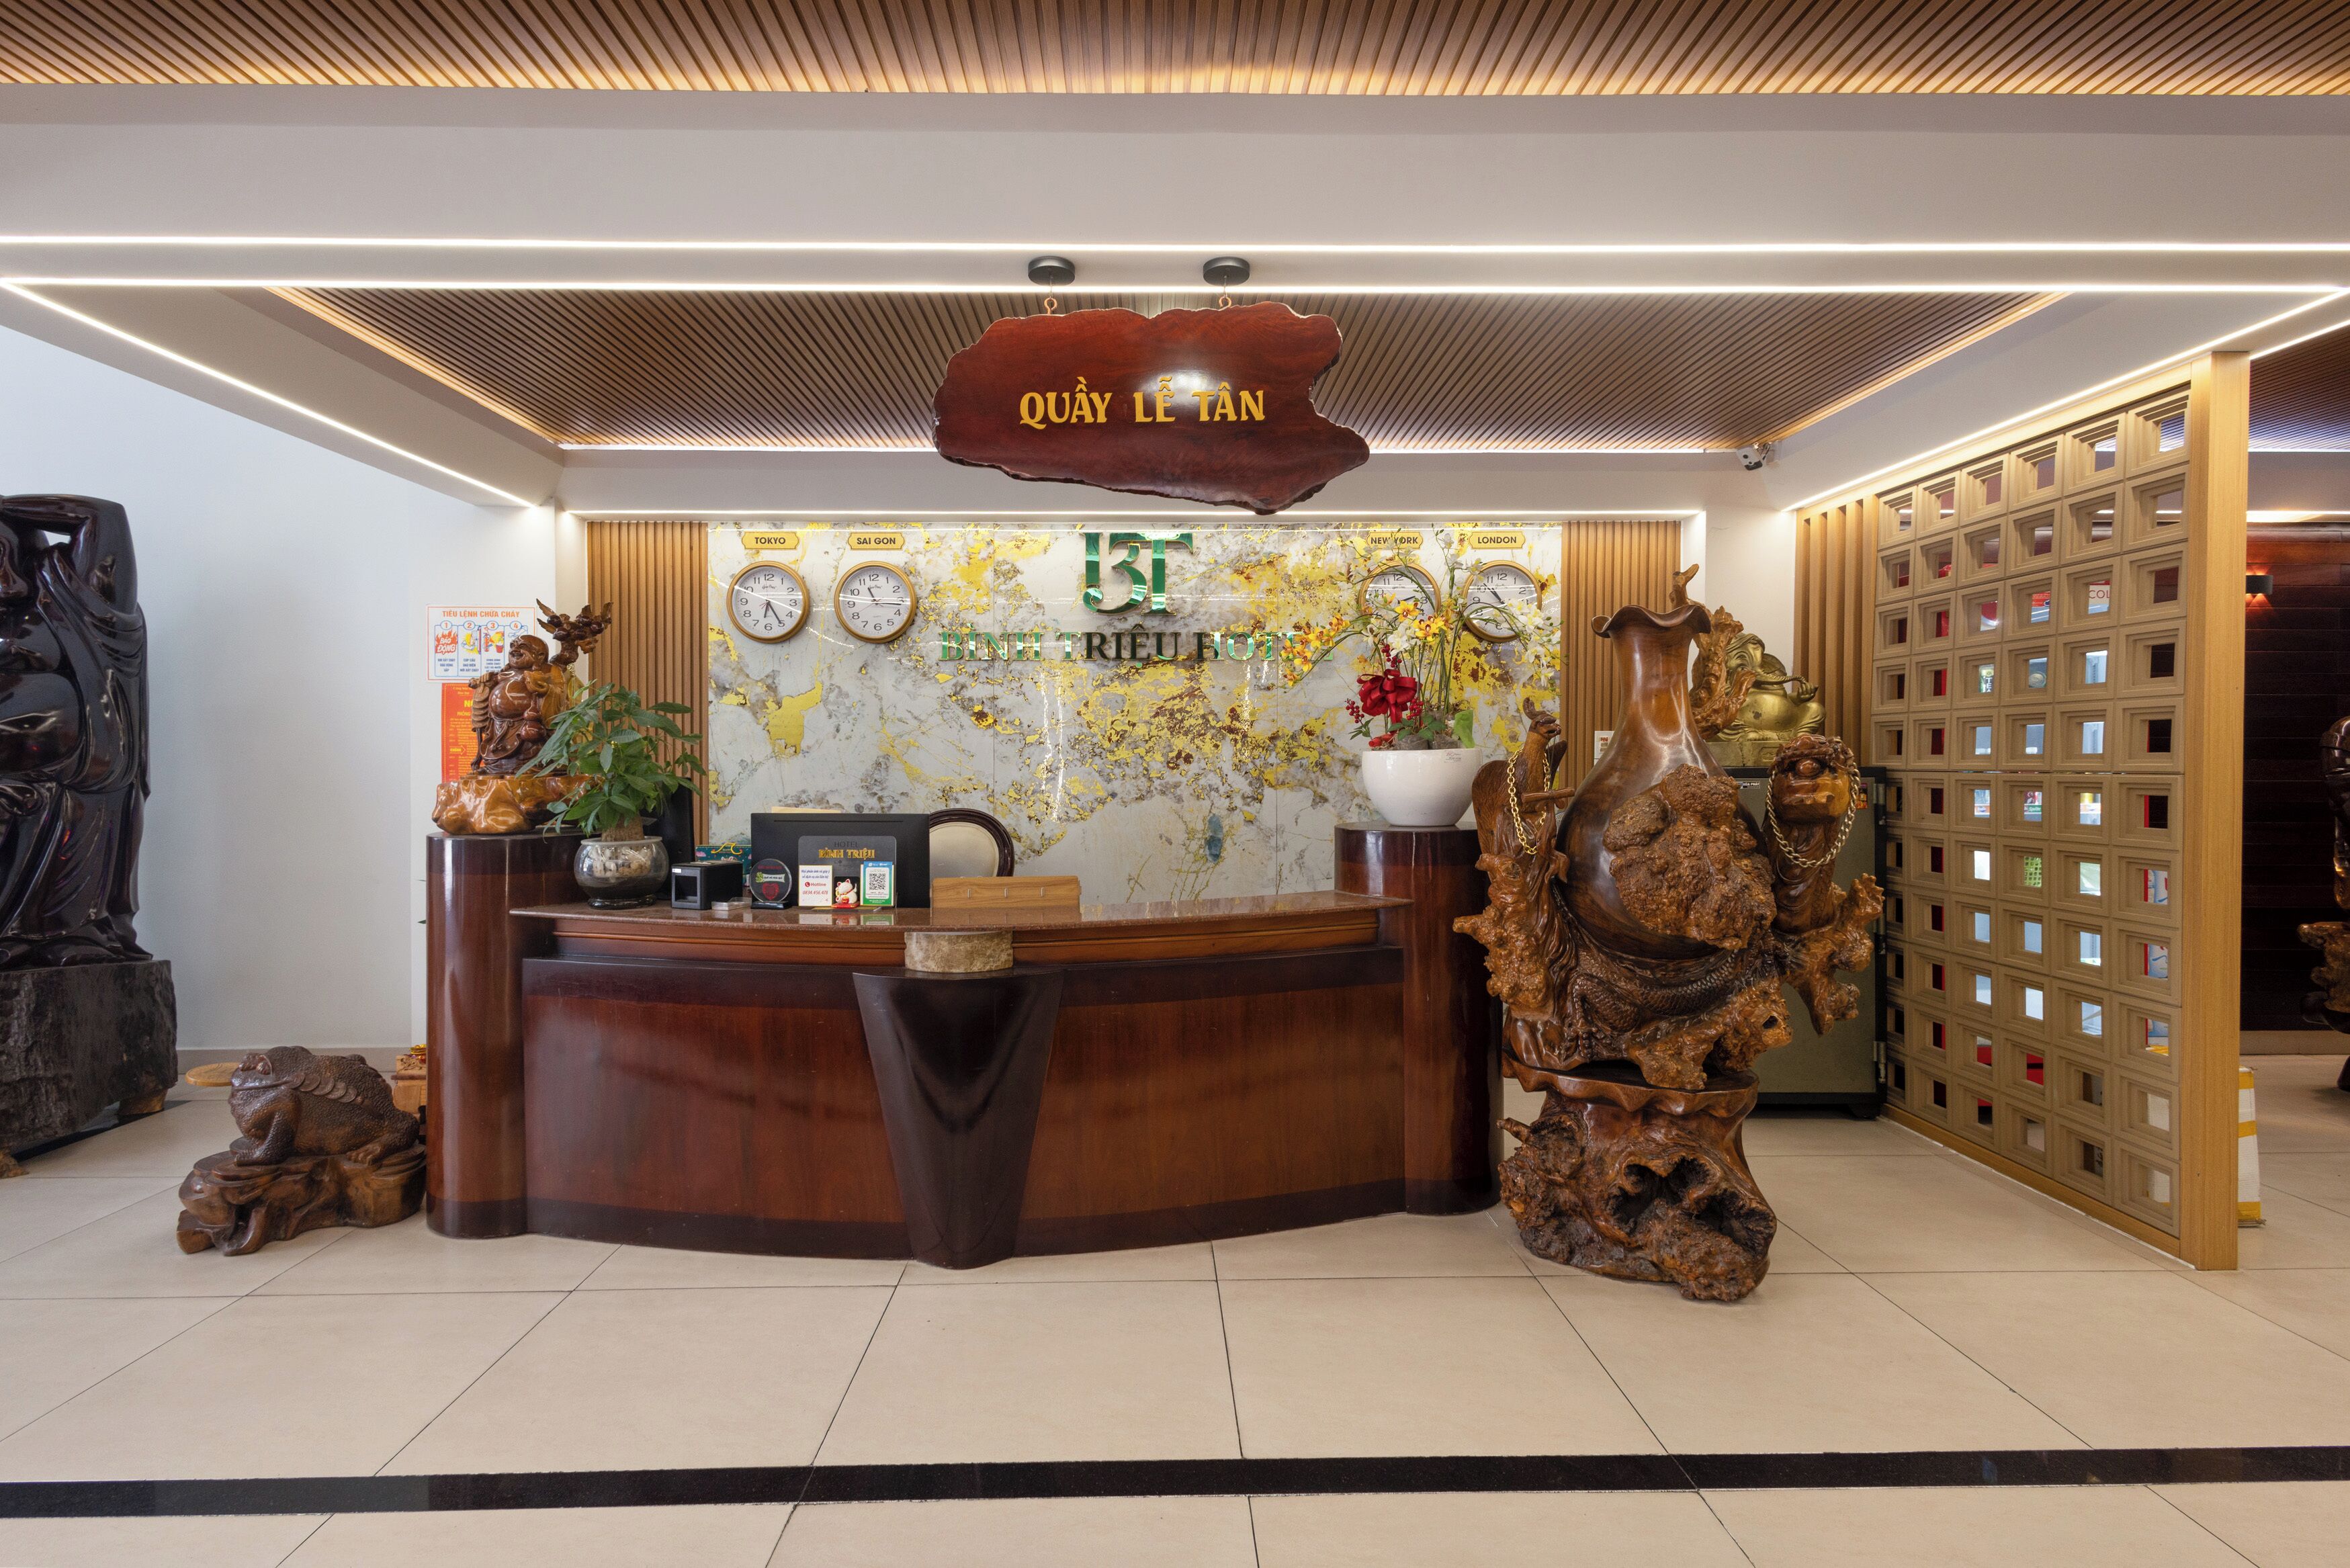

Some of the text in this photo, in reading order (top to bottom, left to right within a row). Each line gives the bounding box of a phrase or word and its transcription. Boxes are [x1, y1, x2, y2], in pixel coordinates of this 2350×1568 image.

[1020, 376, 1266, 430] QUẦY LỄ TÂN
[857, 537, 896, 545] SAI GON
[764, 573, 775, 581] 12
[1497, 572, 1508, 580] 12
[1514, 576, 1516, 584] 1
[460, 610, 478, 619] LỆNH
[480, 609, 499, 617] CHỮA
[437, 644, 455, 655] ĐỘNG
[939, 623, 1044, 660] BÌNH
[1055, 622, 1181, 668] TRIỆU
[818, 847, 875, 860] BÌNH TRIỆU
